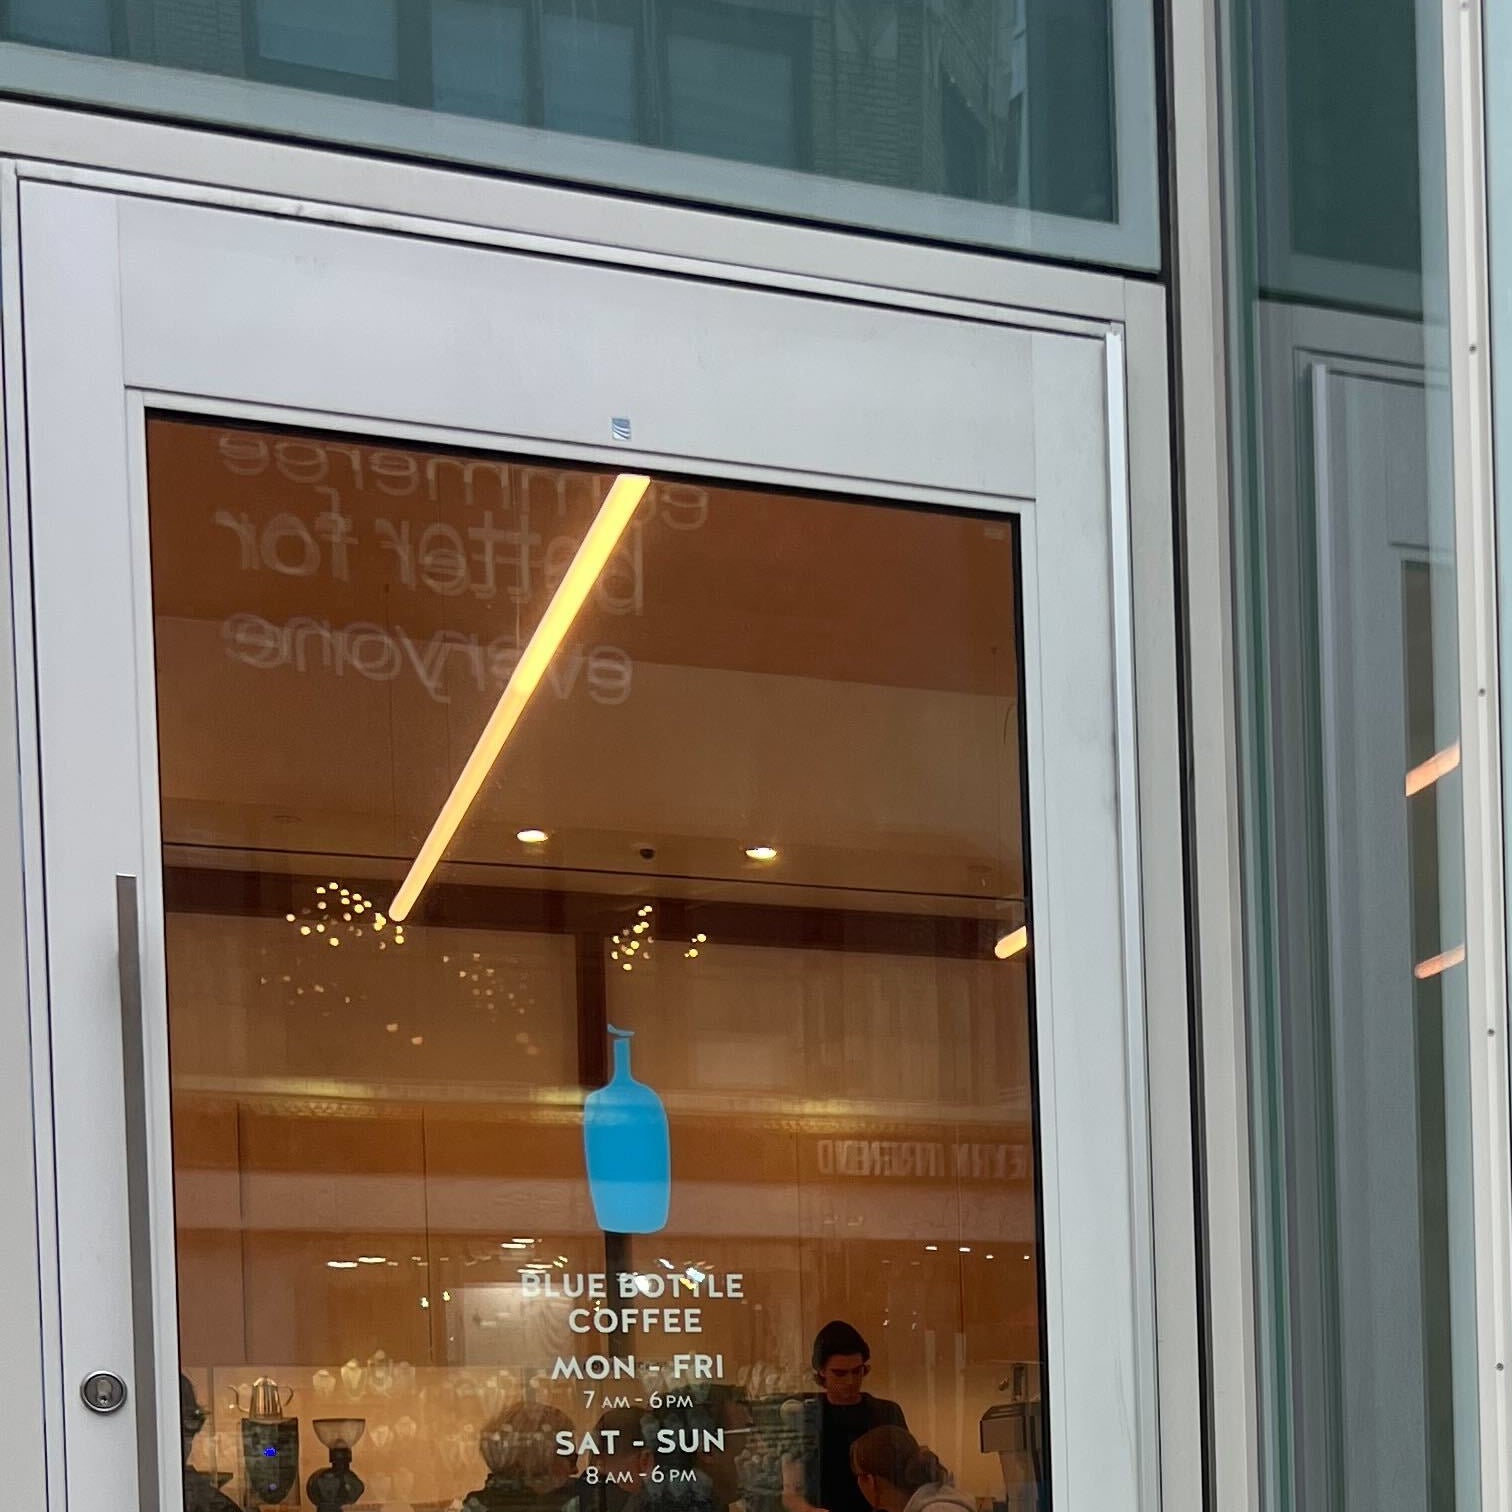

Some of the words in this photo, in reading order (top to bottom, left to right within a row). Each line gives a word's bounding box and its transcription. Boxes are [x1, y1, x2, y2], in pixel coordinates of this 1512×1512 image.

[521, 1273, 607, 1298] BLUE
[618, 1273, 744, 1298] BOTTLE
[568, 1308, 702, 1333] COFFEE
[551, 1355, 635, 1380] MON
[674, 1354, 724, 1379] FRI
[555, 1430, 620, 1455] SAT
[657, 1428, 725, 1453] SUN
